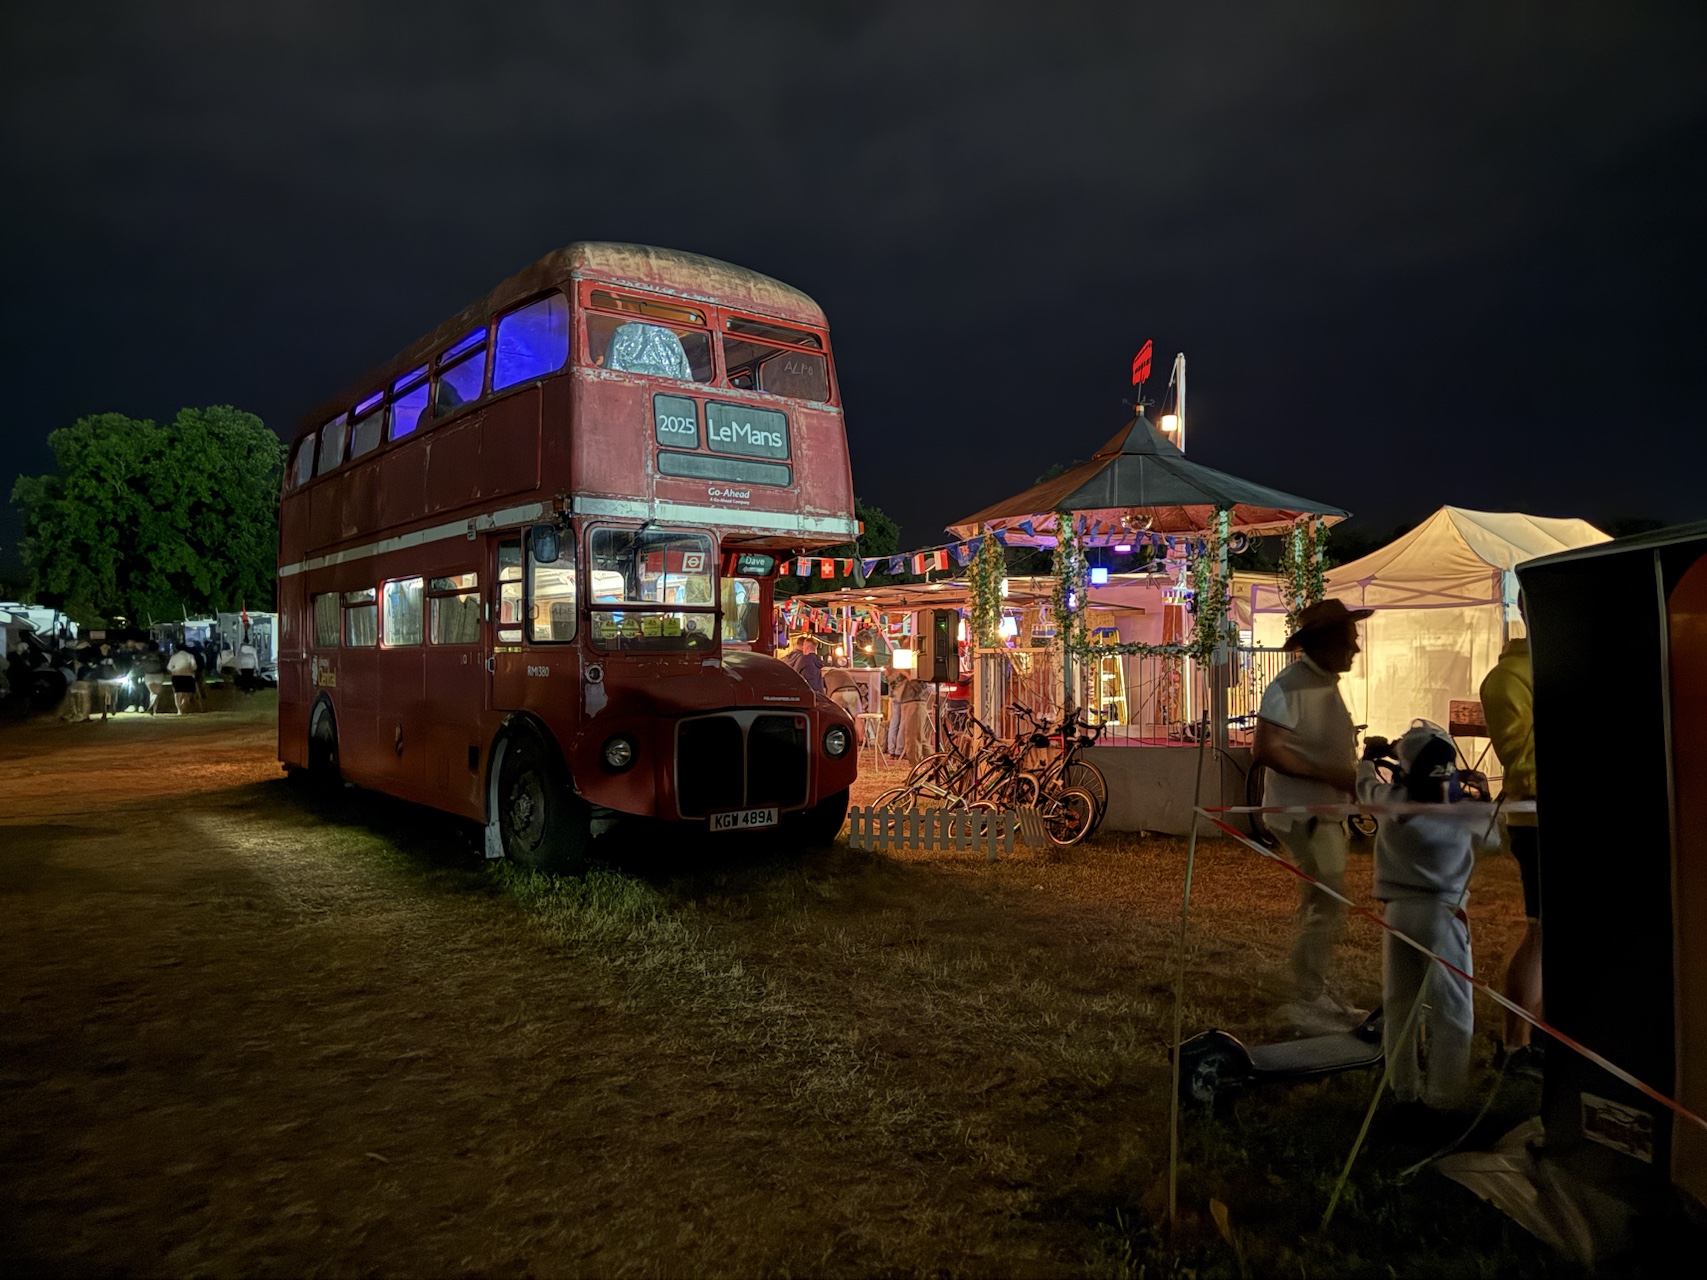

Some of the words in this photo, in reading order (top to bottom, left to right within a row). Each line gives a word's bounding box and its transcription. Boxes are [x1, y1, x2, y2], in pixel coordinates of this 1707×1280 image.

[658, 414, 695, 434] 2025
[708, 418, 783, 447] LeMans
[707, 487, 750, 499] Go-Ahead
[745, 555, 766, 566] Dave
[527, 664, 550, 678] RM1380
[716, 813, 739, 829] KGW
[742, 809, 773, 825] 489A
